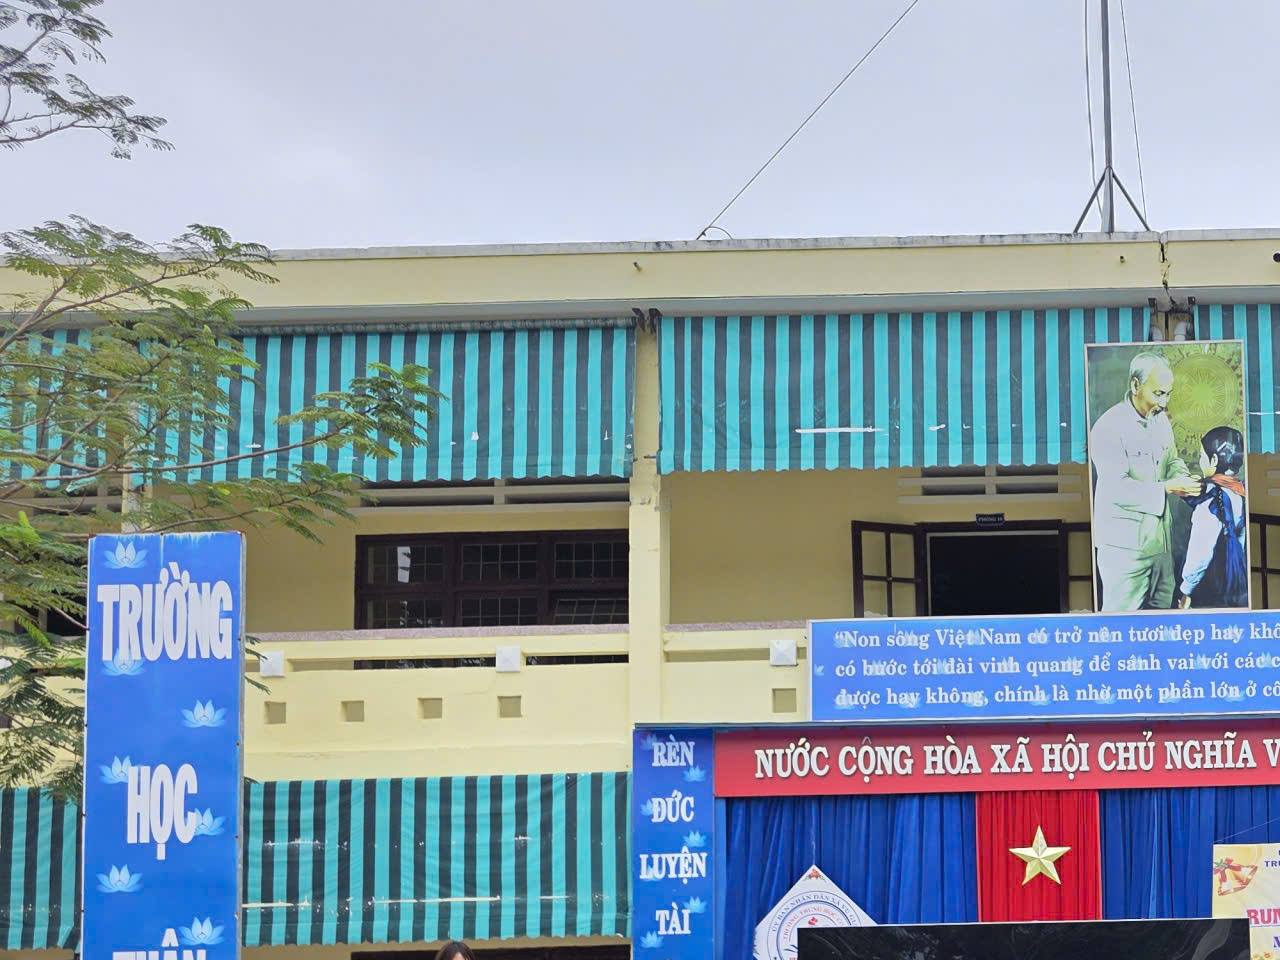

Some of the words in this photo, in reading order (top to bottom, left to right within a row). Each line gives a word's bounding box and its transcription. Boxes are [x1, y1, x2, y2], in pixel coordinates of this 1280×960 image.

[97, 561, 233, 661] TRƯỜNG
[887, 631, 929, 650] sông
[936, 628, 973, 648] Việt
[979, 628, 1021, 645] Nam
[1028, 627, 1048, 644] có
[1055, 624, 1082, 643] trở
[1088, 623, 1123, 642] nên
[1129, 625, 1164, 642] tươi
[1171, 624, 1205, 644] đẹp
[1211, 623, 1244, 643] hay
[835, 660, 856, 677] có
[863, 659, 907, 677] bước
[913, 657, 938, 676] tới
[946, 656, 973, 674] đài
[979, 656, 1021, 674] vinh
[1026, 657, 1083, 676] quang
[1089, 651, 1112, 672] để
[1167, 653, 1194, 670] vai
[1200, 652, 1229, 670] với
[1235, 652, 1265, 669] các
[835, 689, 881, 709] được
[886, 688, 920, 708] hay
[926, 687, 989, 707] không,
[994, 685, 1046, 703] chính
[1052, 684, 1070, 701] là
[1076, 683, 1111, 701] nhờ
[1117, 681, 1152, 701] một
[1158, 679, 1205, 703] phần
[1210, 681, 1241, 698] lớn
[1246, 679, 1257, 697] ở
[652, 734, 696, 767] RÈN
[755, 738, 830, 778] NƯỚC
[838, 735, 913, 783] CỘNG
[923, 735, 982, 775] HÒA
[990, 736, 1033, 774] XÃ
[1041, 733, 1090, 780] HỘI
[1098, 730, 1156, 773] CHỦ
[1165, 732, 1257, 770] NGHĨA
[127, 763, 198, 860] HỌC
[651, 790, 695, 823] ĐỨC
[639, 846, 708, 885] LUYỆN
[655, 902, 692, 935] TÀI
